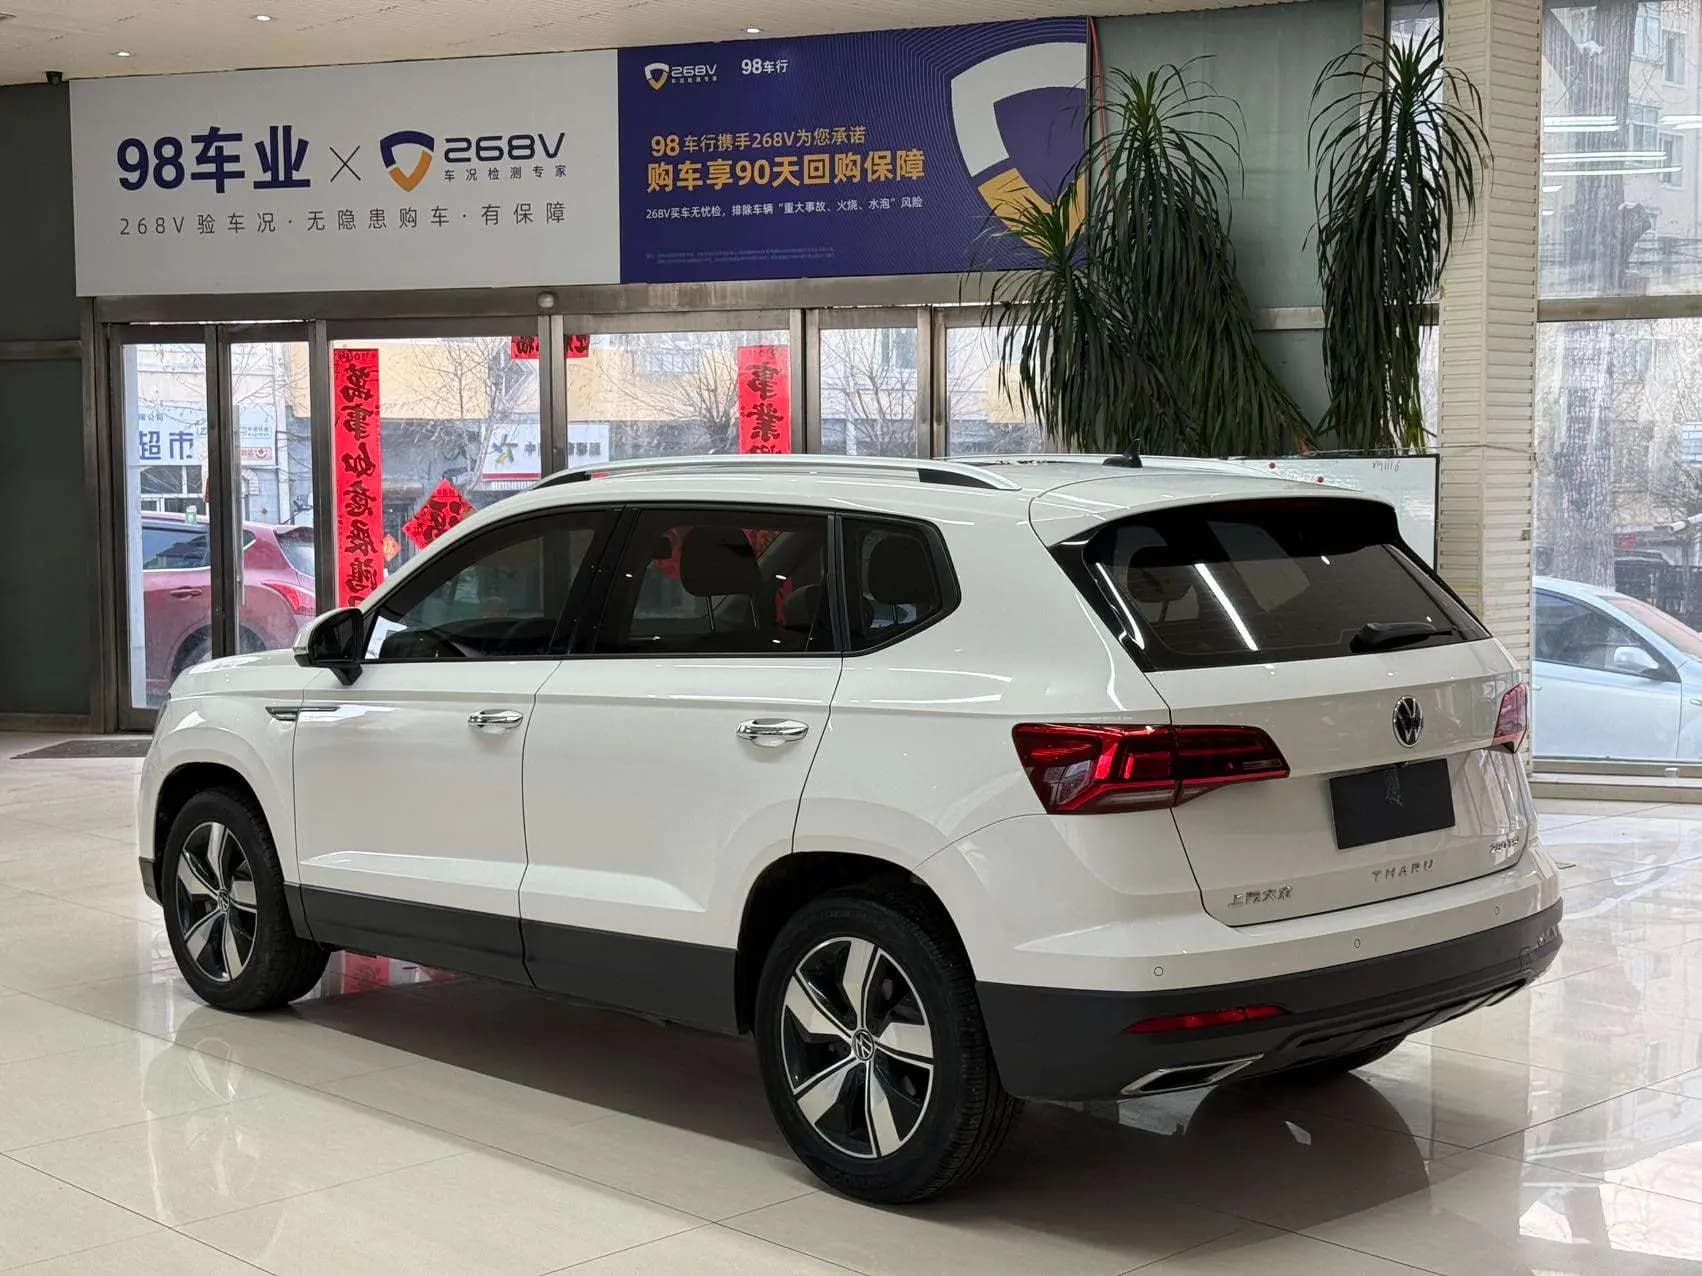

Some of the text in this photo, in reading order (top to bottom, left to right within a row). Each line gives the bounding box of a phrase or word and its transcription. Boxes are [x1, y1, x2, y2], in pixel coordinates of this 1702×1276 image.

[672, 64, 717, 78] 268V
[741, 58, 788, 75] 98车行
[117, 125, 311, 194] 98车业
[444, 132, 566, 163] 268V
[443, 164, 567, 182] 车况检测专家
[647, 148, 926, 193] 购车享90天回购保障
[139, 430, 194, 460] 超市
[1371, 859, 1434, 882] THARU
